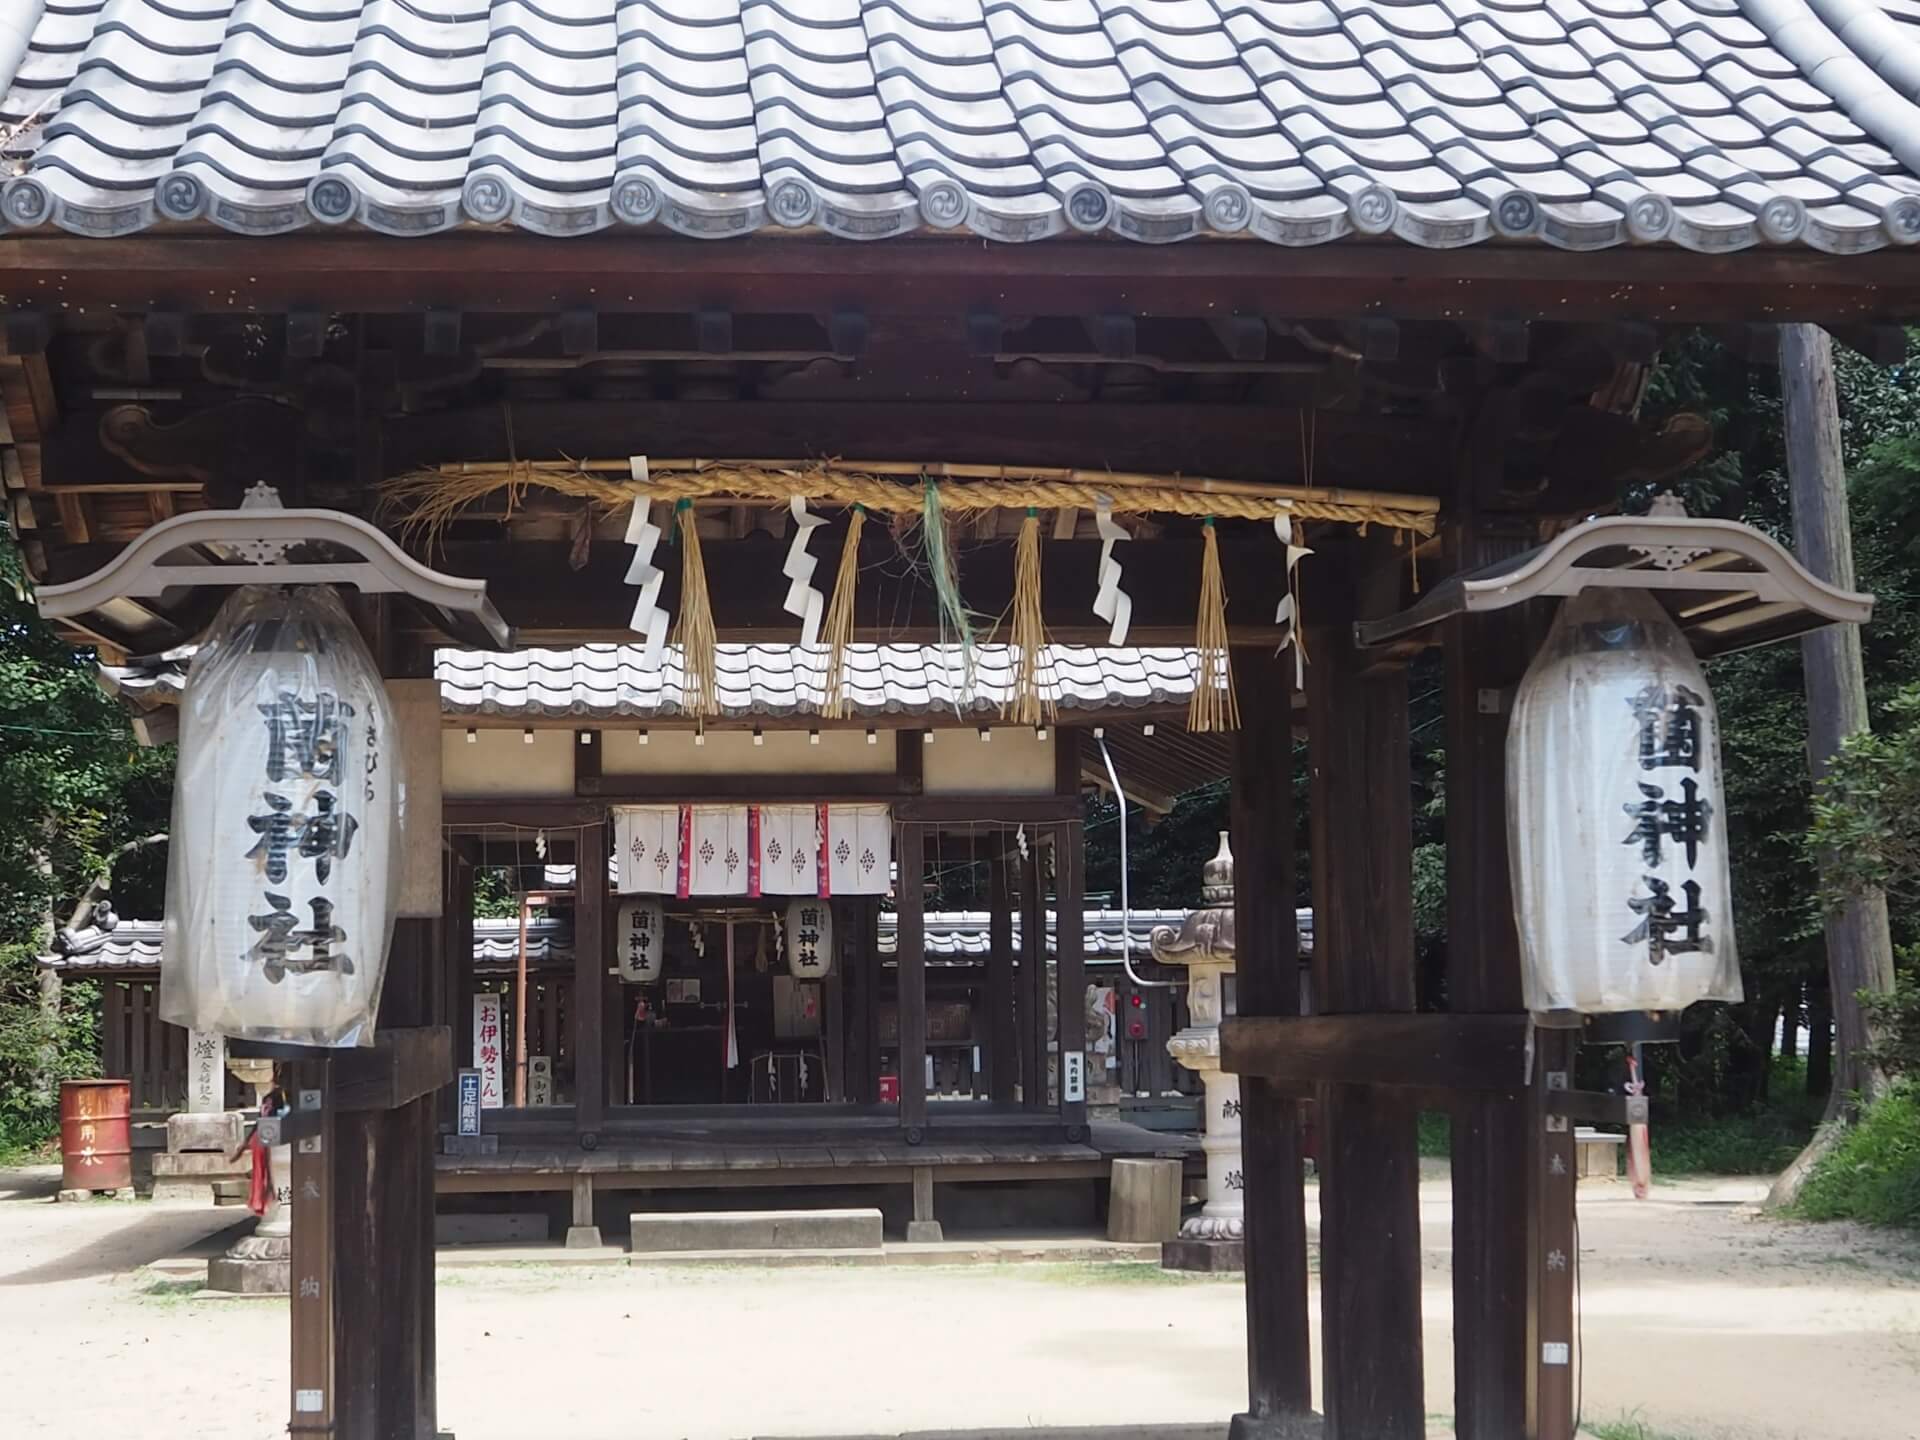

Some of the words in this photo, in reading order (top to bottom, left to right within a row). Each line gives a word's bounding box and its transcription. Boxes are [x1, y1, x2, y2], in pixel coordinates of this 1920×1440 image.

[364, 701, 379, 802] くさびら
[239, 691, 359, 985] 菌神社
[1620, 682, 1714, 967] 菌神社
[629, 909, 651, 971] 菌神社
[798, 907, 819, 968] 菌神社
[193, 1031, 217, 1060] 燈
[479, 1005, 500, 1098] お伊勢さん
[461, 1076, 478, 1133] 土足厳禁
